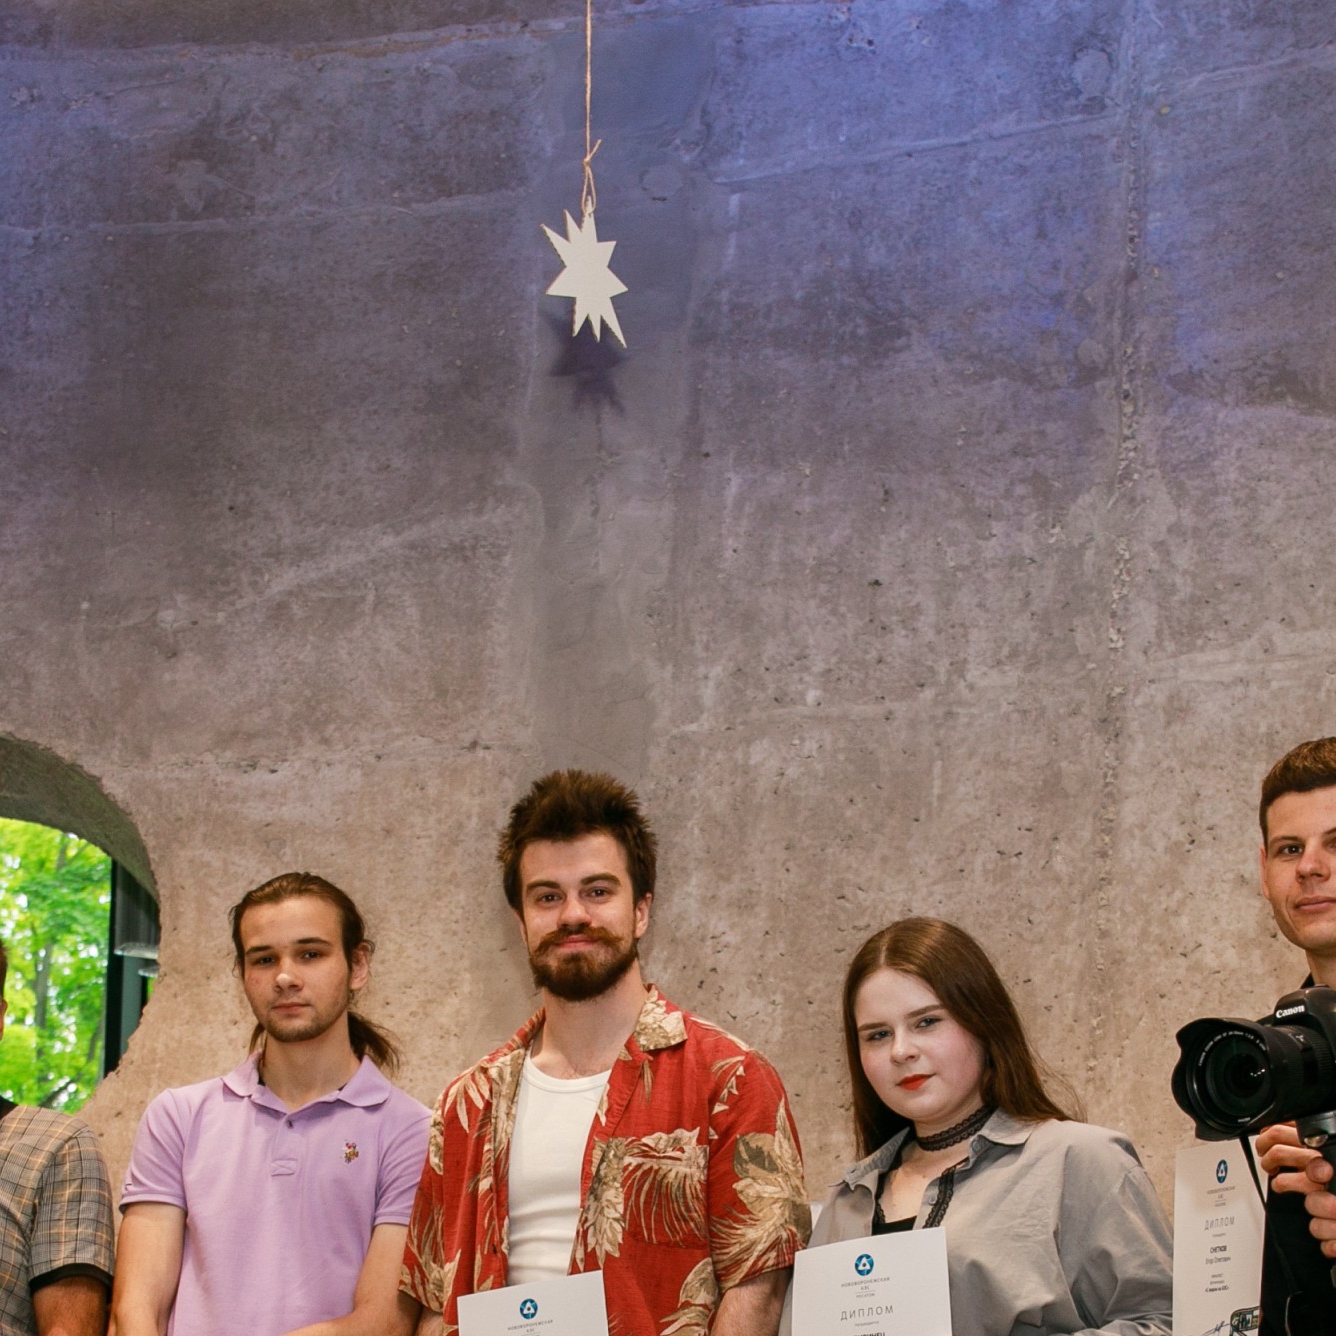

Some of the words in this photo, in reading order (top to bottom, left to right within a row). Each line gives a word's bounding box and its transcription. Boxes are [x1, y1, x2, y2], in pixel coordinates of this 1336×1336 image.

[1275, 1004, 1306, 1019] Canon
[1204, 1216, 1235, 1231] ДИПЛОМ
[840, 1305, 894, 1321] ДИПЛОМ
